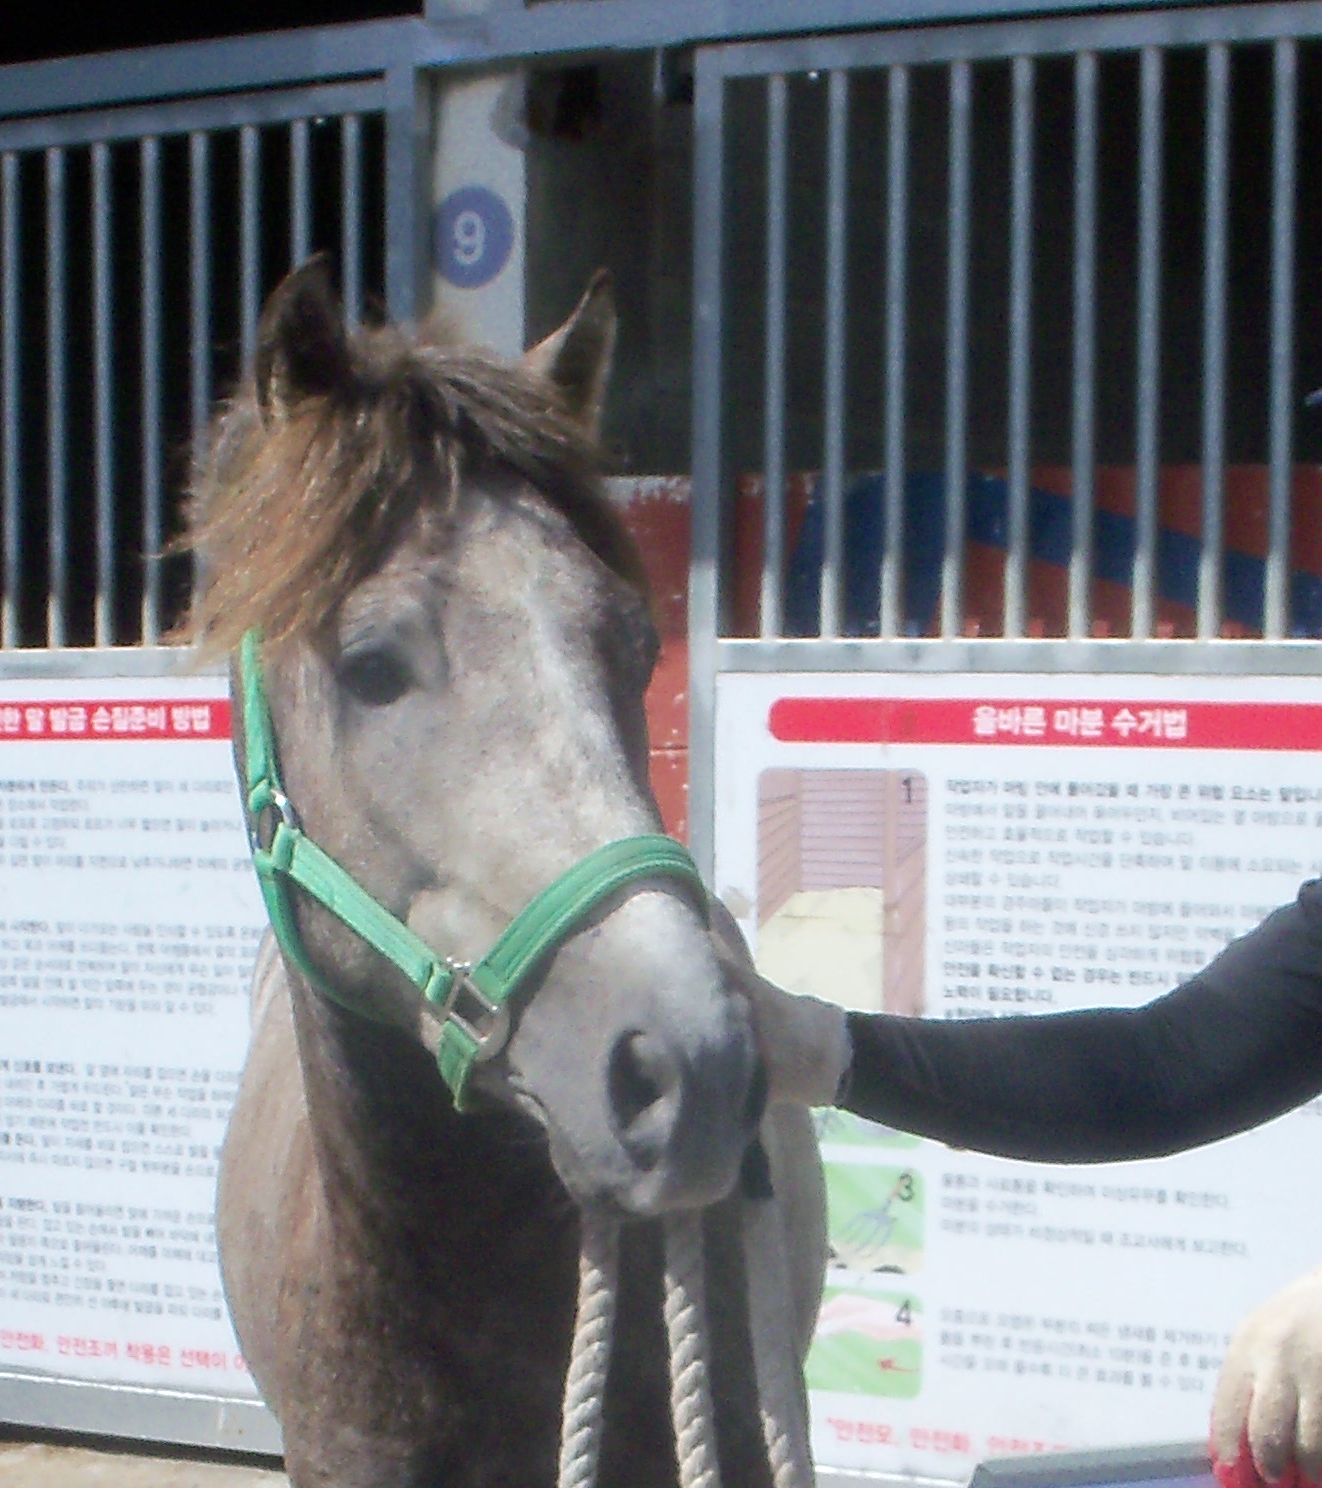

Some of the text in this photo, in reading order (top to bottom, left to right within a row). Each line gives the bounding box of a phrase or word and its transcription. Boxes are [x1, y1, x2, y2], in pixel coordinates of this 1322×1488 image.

[455, 210, 486, 266] 9
[24, 707, 45, 733] 말
[91, 706, 166, 733] 손질준비
[171, 705, 212, 732] 방법
[974, 706, 1188, 739] 올바른 마분 수거법
[901, 776, 913, 804] 1
